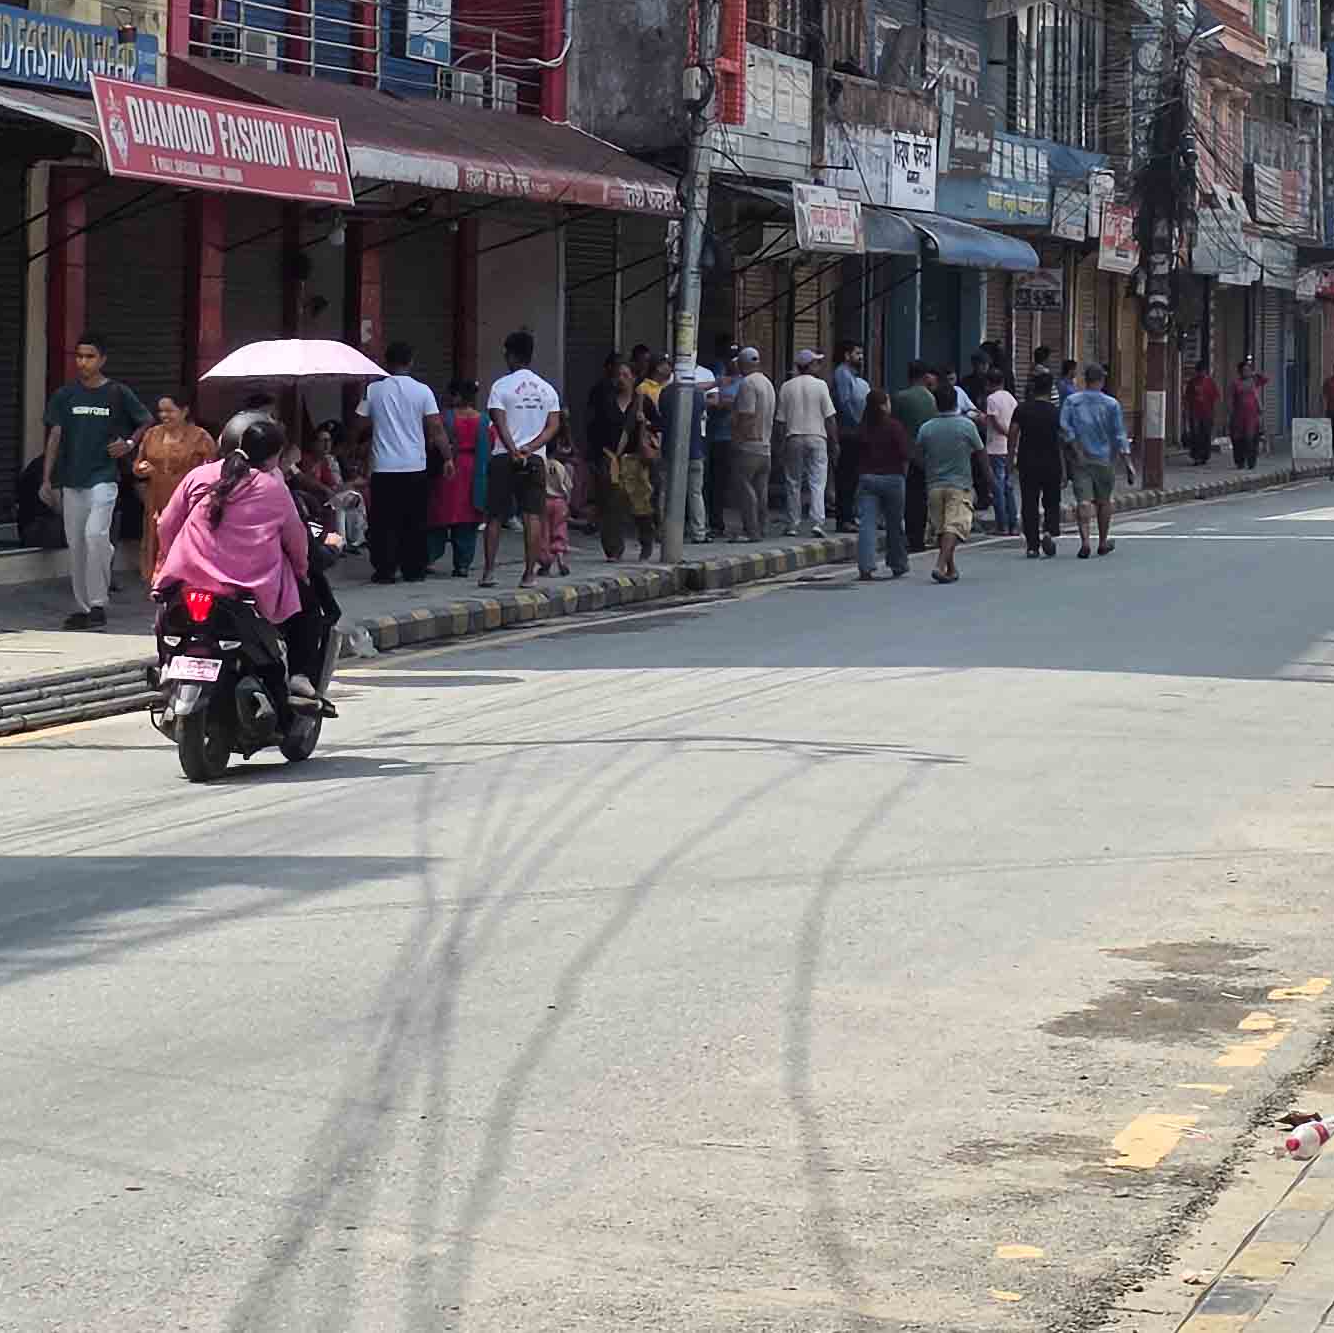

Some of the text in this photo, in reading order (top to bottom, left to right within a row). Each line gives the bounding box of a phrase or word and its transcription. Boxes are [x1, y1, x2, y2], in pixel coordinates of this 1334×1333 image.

[17, 17, 89, 82] FASHION
[125, 95, 215, 155] DIAMOND
[217, 112, 291, 168] FASHION
[291, 124, 342, 175] WEAR
